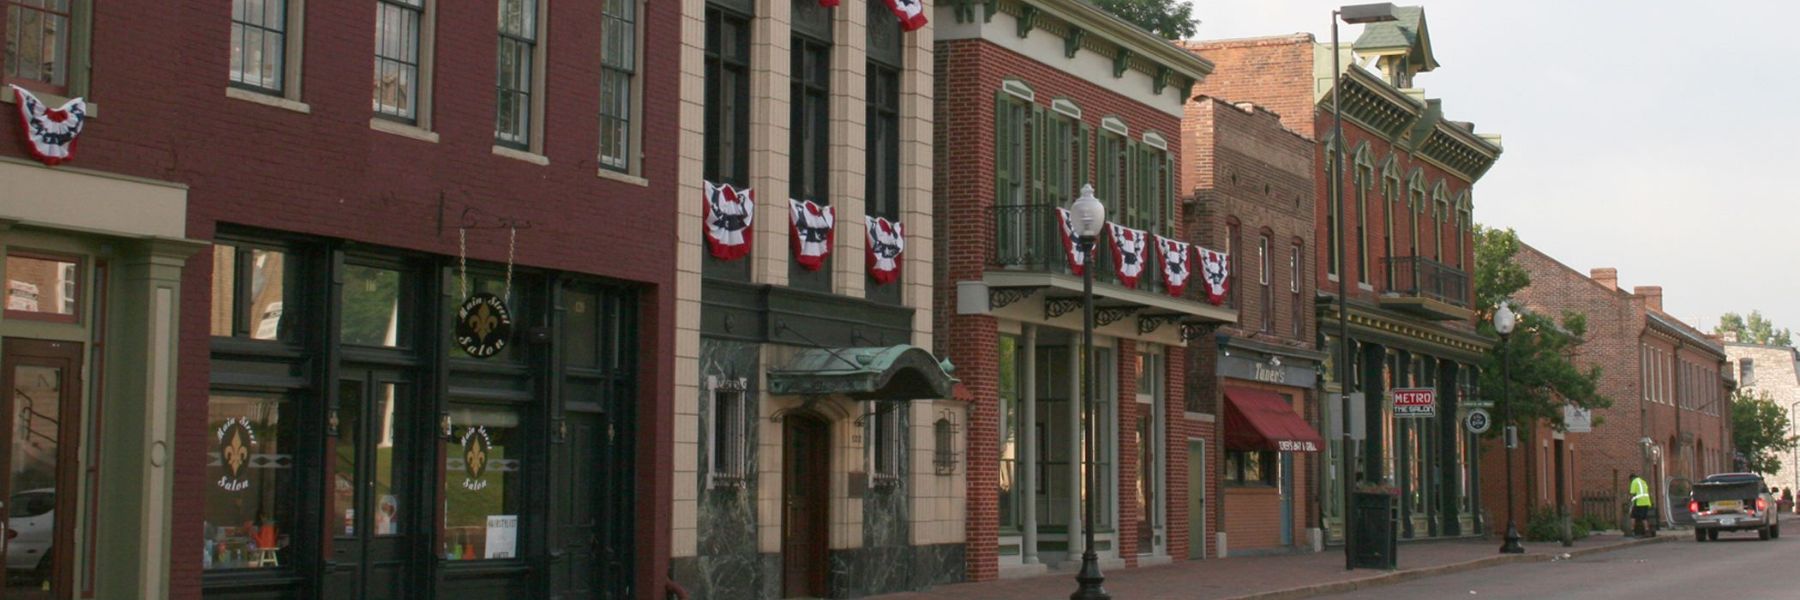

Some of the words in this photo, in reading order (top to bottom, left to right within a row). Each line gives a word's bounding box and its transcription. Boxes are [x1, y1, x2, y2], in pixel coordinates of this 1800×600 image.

[459, 296, 482, 320] Main
[488, 296, 511, 325] Street
[458, 336, 505, 356] Salon
[1394, 392, 1432, 404] METRO
[217, 416, 236, 441] Main
[239, 415, 257, 445] Street
[461, 427, 475, 447] Main
[478, 425, 493, 450] Street
[217, 475, 249, 492] Salon
[462, 477, 487, 491] Salon
